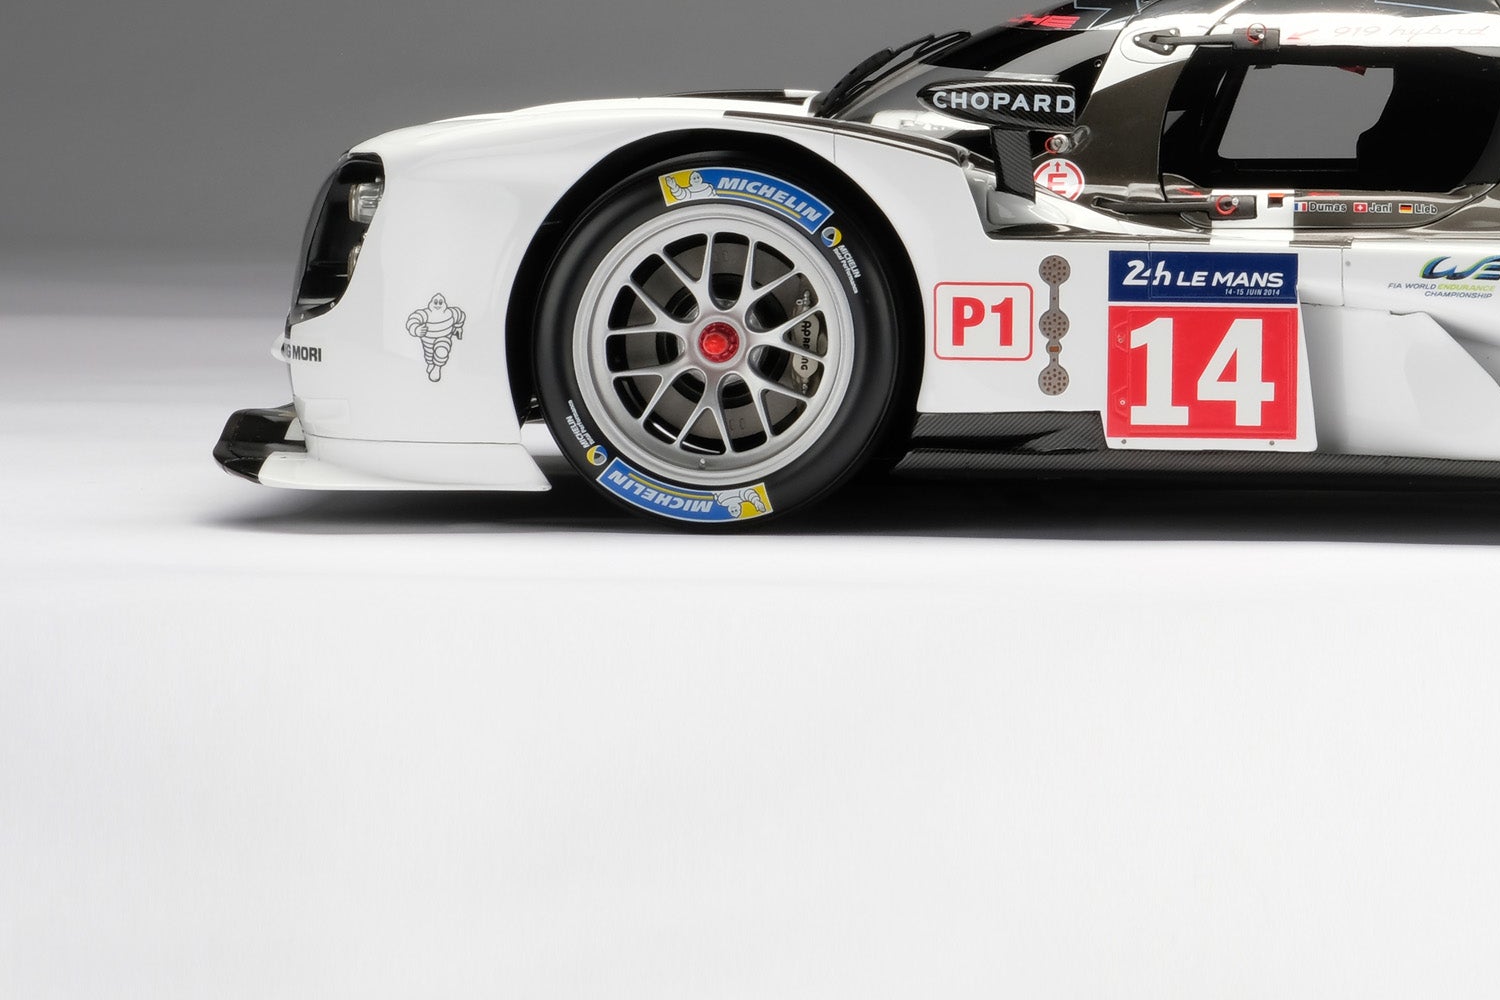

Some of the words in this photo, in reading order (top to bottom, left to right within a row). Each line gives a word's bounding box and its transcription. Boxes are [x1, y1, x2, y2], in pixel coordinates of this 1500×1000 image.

[1334, 25, 1381, 37] 919
[932, 91, 1076, 114] CHOPARD
[717, 177, 823, 222] MICHELIN
[1308, 202, 1347, 212] Dumas
[1369, 202, 1393, 213] Jani
[1415, 203, 1438, 215] Lieb
[839, 244, 862, 279] MICHELIN
[1176, 271, 1209, 286] LE
[1211, 272, 1284, 288] MANS
[1437, 283, 1496, 291] ENDURANCE
[1225, 288, 1244, 296] 14-15
[1246, 288, 1262, 296] JUIN
[1263, 288, 1280, 296] 2014
[1424, 290, 1493, 299] CHAMPIONSHIP
[952, 296, 1013, 346] P1
[292, 344, 322, 362] MORI
[1130, 317, 1275, 427] 14
[565, 415, 589, 449] MICHELIN
[608, 470, 714, 512] MICHELIN
